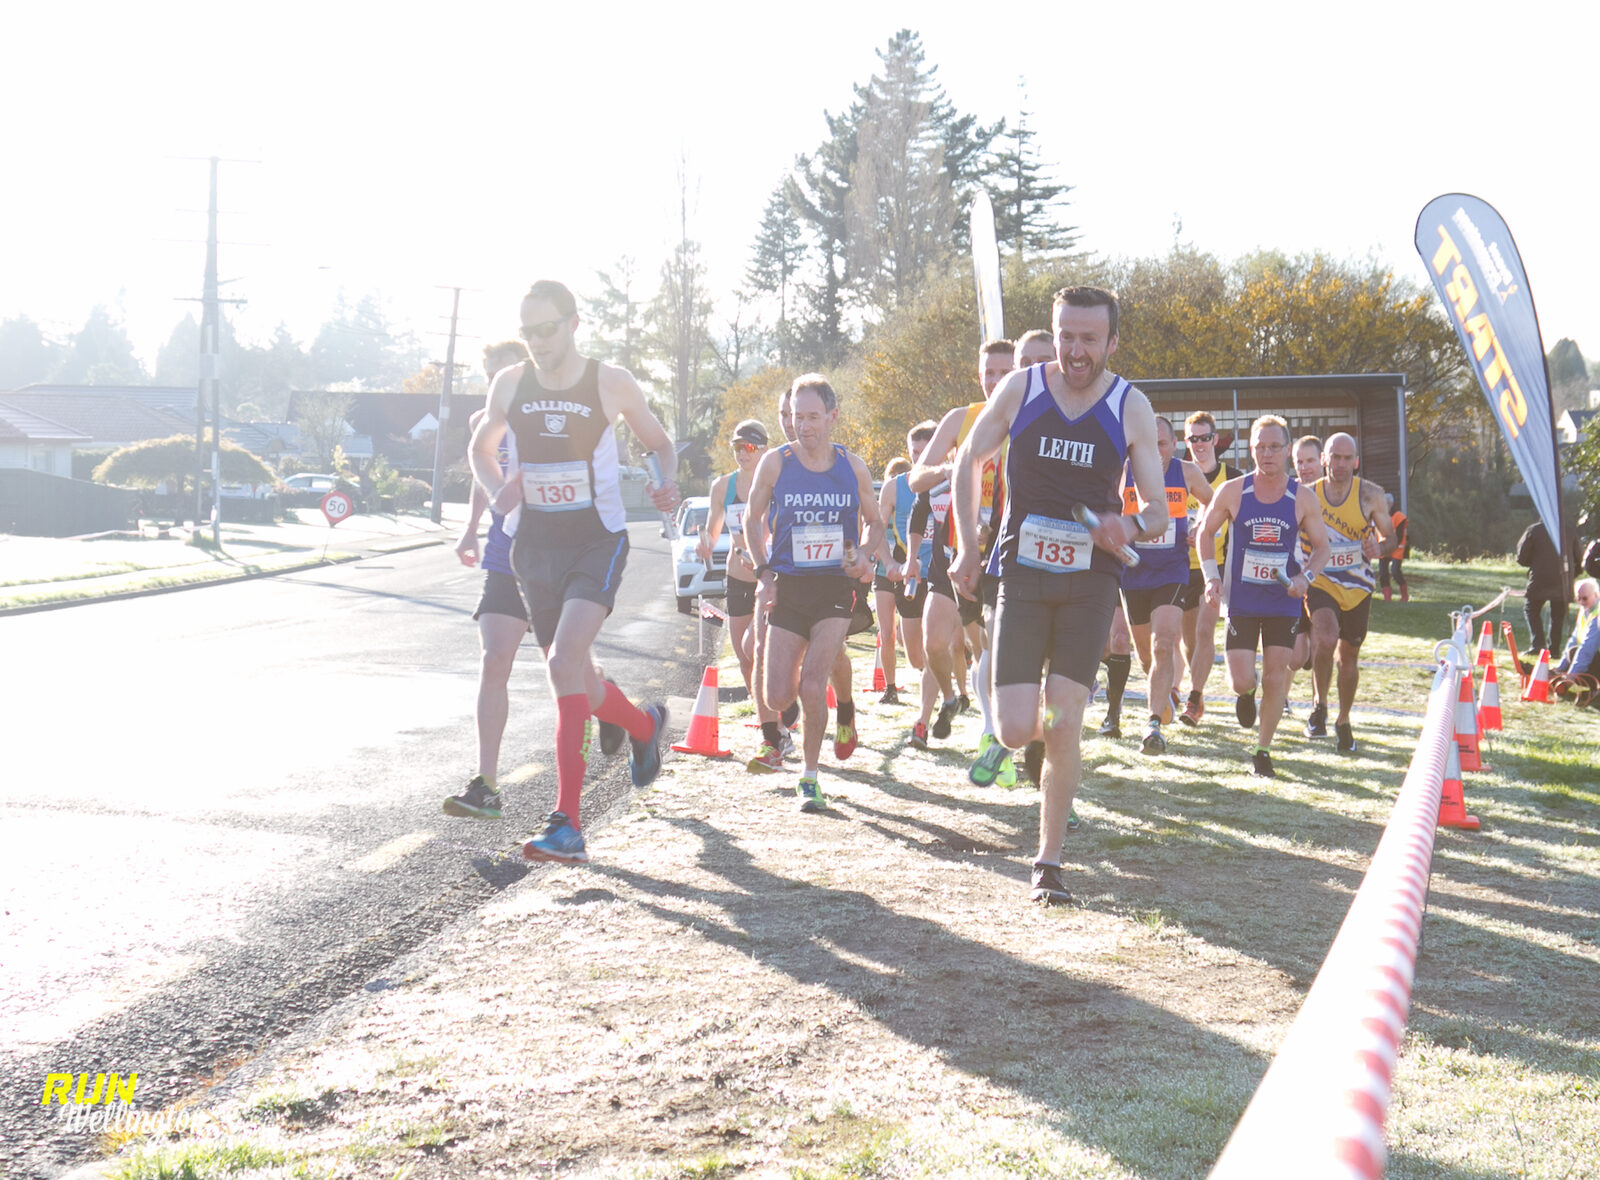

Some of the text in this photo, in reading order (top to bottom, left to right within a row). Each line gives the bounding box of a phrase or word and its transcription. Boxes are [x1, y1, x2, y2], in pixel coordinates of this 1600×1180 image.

[521, 400, 592, 418] CALLIOPE
[1038, 436, 1095, 464] LEITH
[536, 484, 576, 504] 130
[784, 493, 852, 507] PAPANUI
[328, 499, 346, 514] 50
[794, 510, 840, 523] TOC H
[1244, 516, 1290, 530] WELLINGTON
[804, 543, 834, 560] 177
[1034, 540, 1076, 566] 133
[1331, 554, 1354, 567] 165
